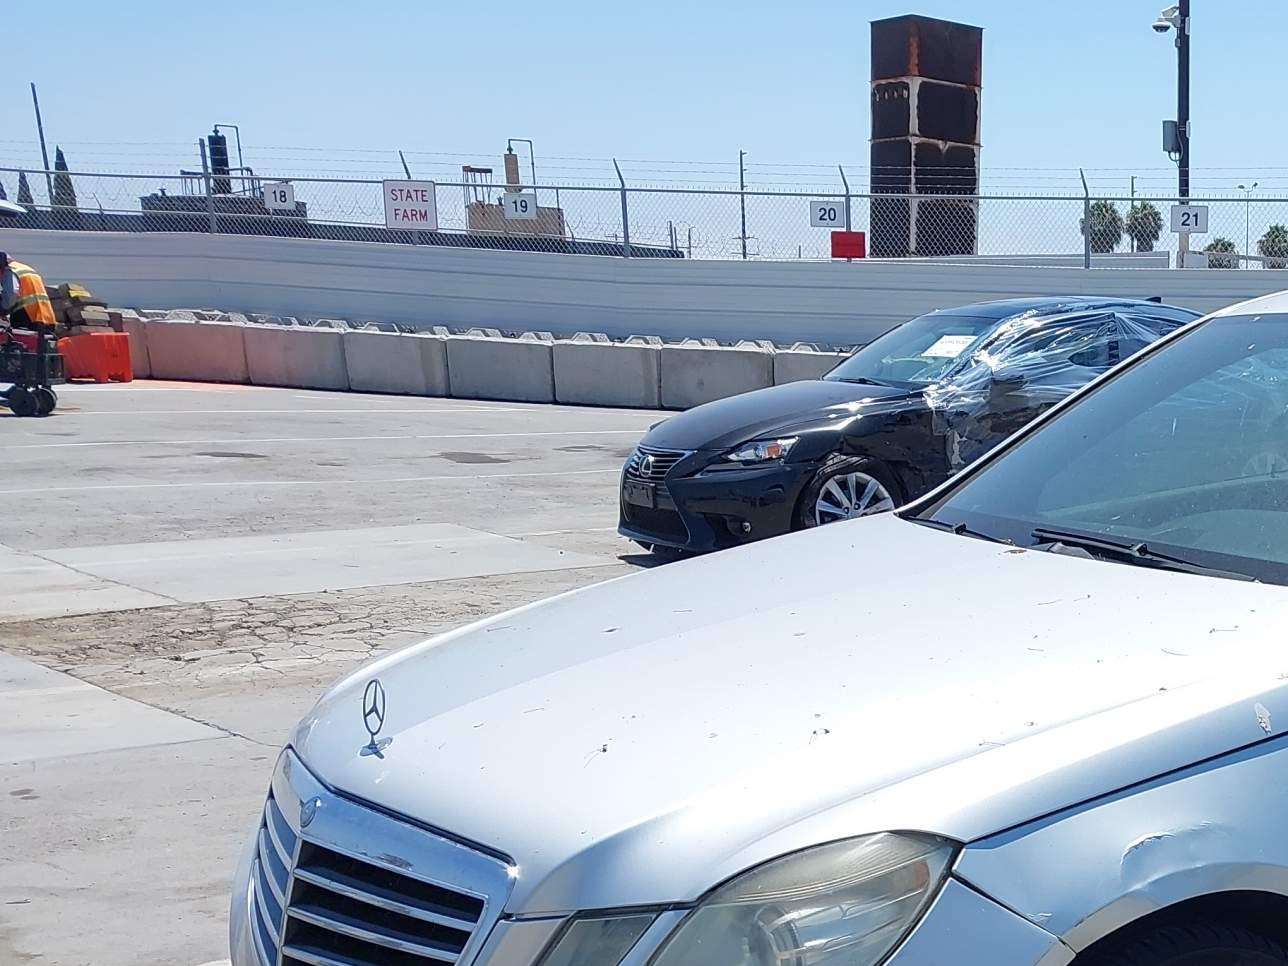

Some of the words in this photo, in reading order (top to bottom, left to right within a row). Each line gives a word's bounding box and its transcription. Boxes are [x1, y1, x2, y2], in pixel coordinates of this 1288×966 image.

[272, 190, 287, 203] 18
[391, 189, 429, 202] STATE
[512, 199, 528, 213] 19
[394, 208, 428, 222] FARM
[818, 207, 837, 221] 20
[1181, 211, 1199, 226] 21
